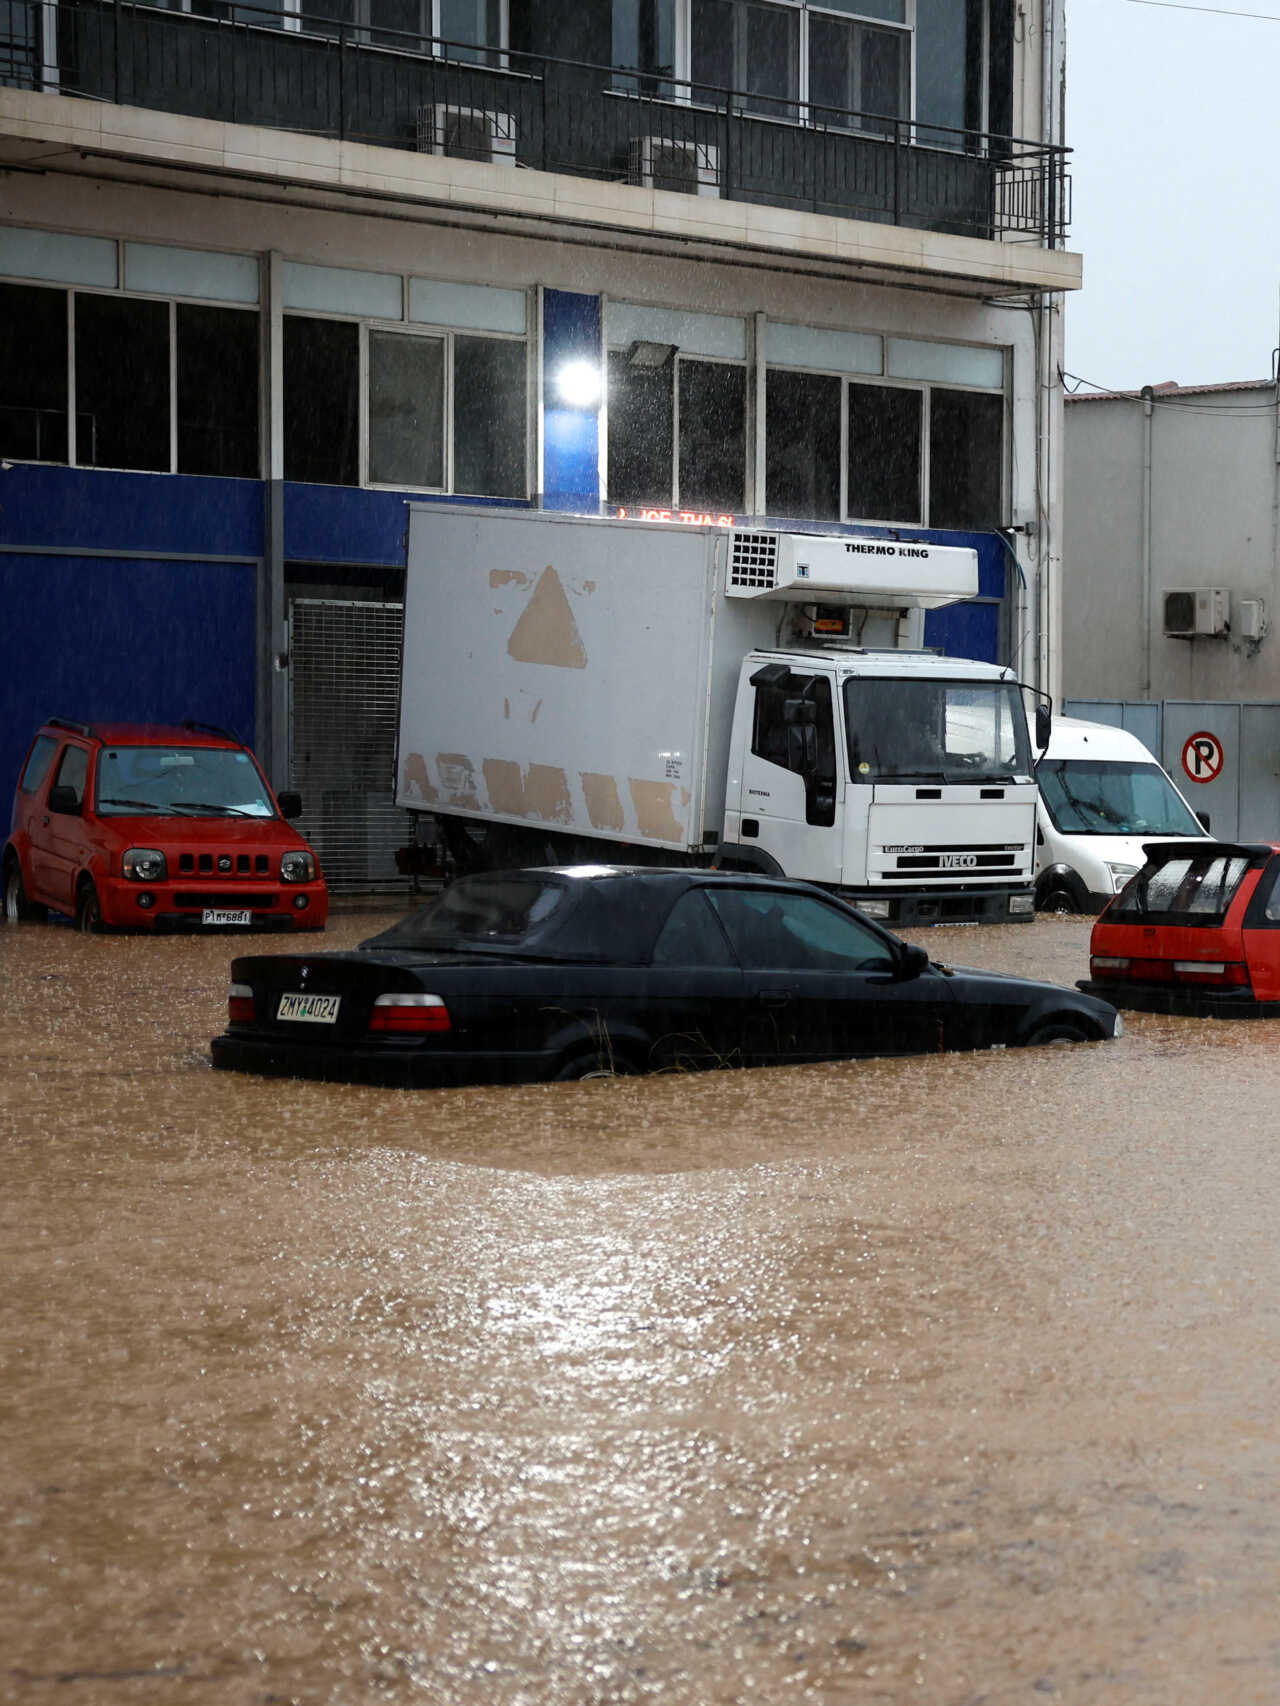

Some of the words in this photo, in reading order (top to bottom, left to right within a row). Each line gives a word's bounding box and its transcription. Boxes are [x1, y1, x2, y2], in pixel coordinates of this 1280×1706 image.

[845, 543, 896, 557] THERMO
[898, 547, 929, 559] KING
[939, 855, 977, 867] IVECO
